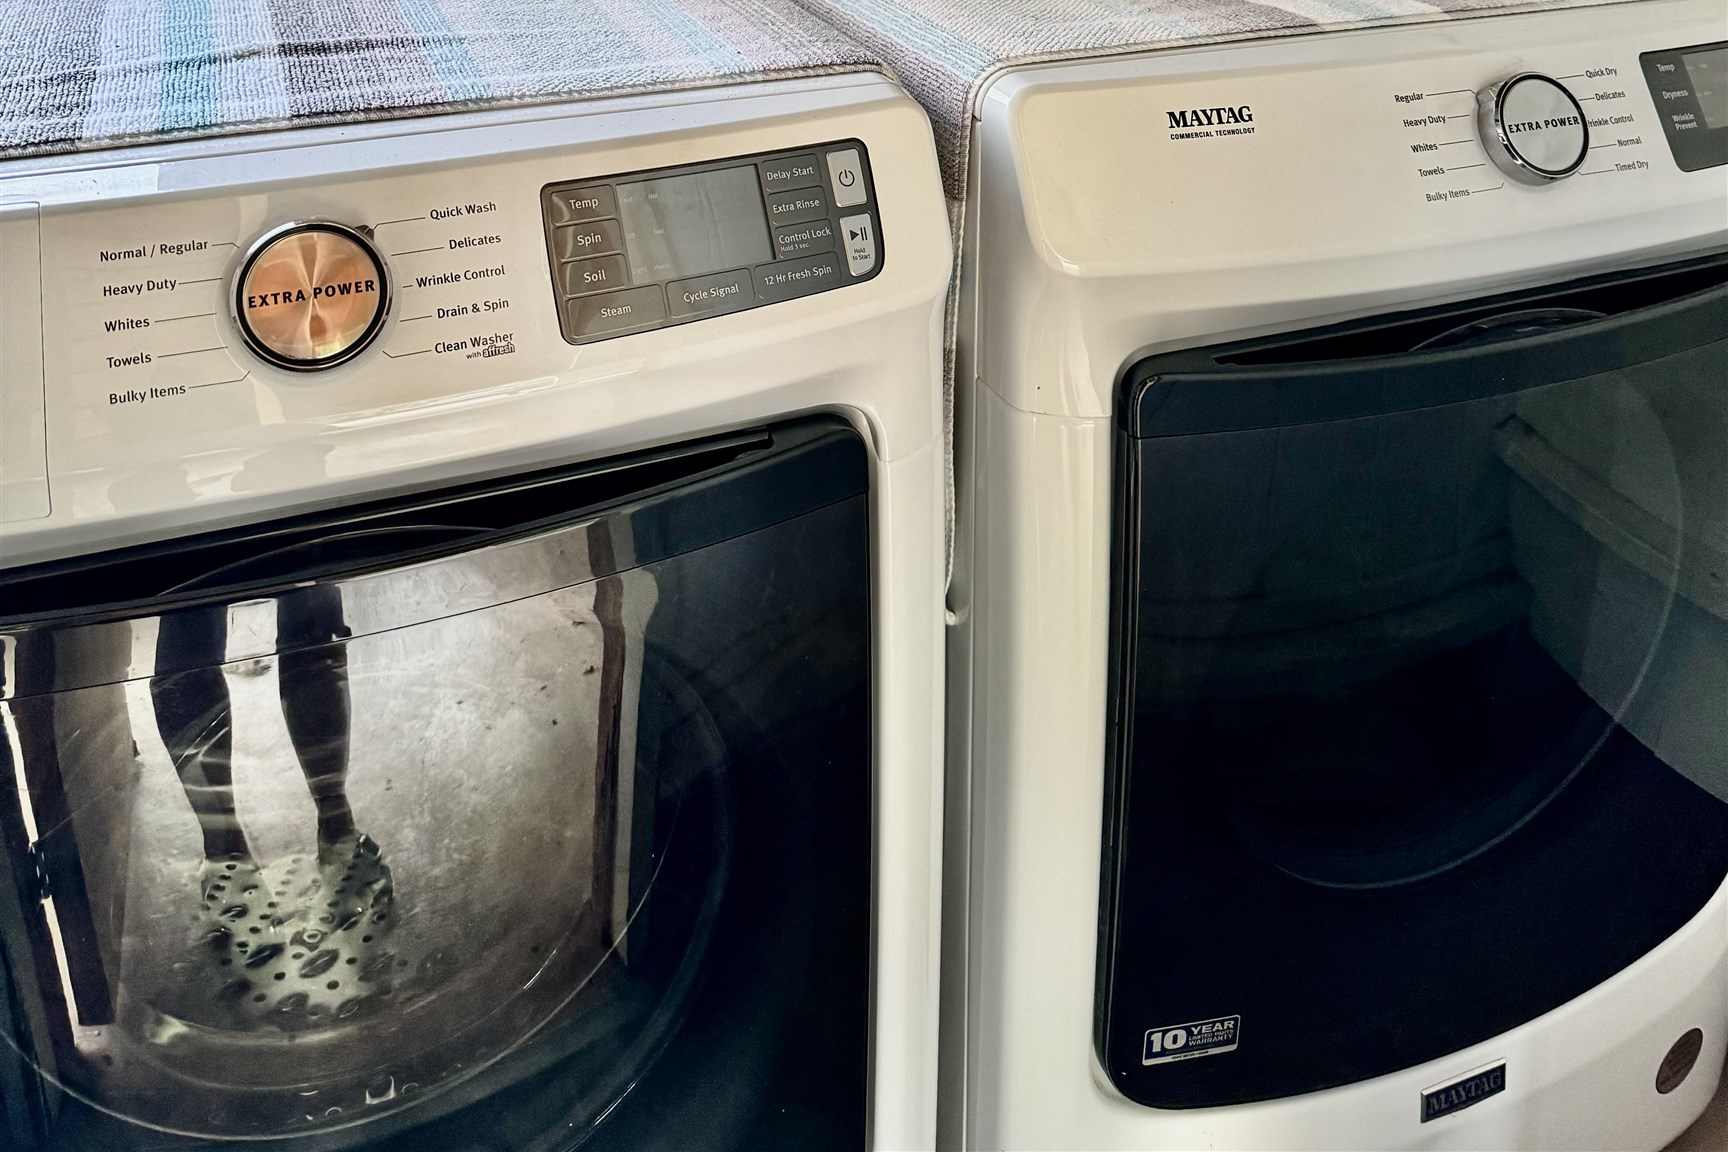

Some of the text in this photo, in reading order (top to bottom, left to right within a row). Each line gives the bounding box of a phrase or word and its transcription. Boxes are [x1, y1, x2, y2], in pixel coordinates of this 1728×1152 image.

[1585, 67, 1618, 79] Quick Dry
[1656, 63, 1675, 72] Temp
[1394, 92, 1424, 104] Regular
[1594, 90, 1626, 101] Delicates
[1662, 89, 1688, 100] Dryness
[1166, 106, 1253, 129] MAYTAG
[1403, 114, 1446, 127] Heavy Duty
[1508, 116, 1580, 133] EXTRA POWER
[1587, 114, 1634, 128] rinkle Control
[1672, 113, 1695, 122] Wrinkle
[1675, 121, 1698, 130] Prevent
[1170, 127, 1255, 141] COMMERCIAL TECHNOLOGY
[1410, 143, 1438, 153] Whites
[1617, 136, 1642, 147] Normal
[766, 166, 814, 181] Delay Start
[1418, 165, 1445, 177] Towels
[1615, 161, 1649, 172] Timed Dry
[1425, 188, 1470, 202] Bulky Items
[569, 197, 599, 210] Temp
[772, 199, 820, 214] Extra Rinse
[430, 201, 497, 221] Quick Wash
[449, 233, 502, 250] Delicates
[577, 233, 602, 247] Spin
[778, 227, 832, 244] Control Lock
[100, 240, 208, 262] Normal / Regular
[780, 244, 794, 252] Hold
[415, 265, 506, 288] Wrinkle Control
[583, 269, 607, 283] Soil
[764, 265, 832, 286] 12 Hr Fresh Spin
[103, 279, 177, 297] Heavy Duty
[248, 279, 375, 309] EXTRA POWER
[683, 283, 740, 303] Cycle Signal
[437, 298, 510, 319] Drain & Spin
[600, 304, 632, 318] Steam
[104, 318, 150, 333] Whites
[434, 332, 514, 354] Clean Washer
[466, 341, 516, 359] with affresh
[106, 352, 152, 368] Towels
[109, 384, 186, 405] Bulky Items
[1150, 1029, 1187, 1052] 10
[1191, 1020, 1234, 1035] YEAR
[1188, 1034, 1232, 1046] WARRANTY
[1428, 1072, 1502, 1114] MAYTAG
